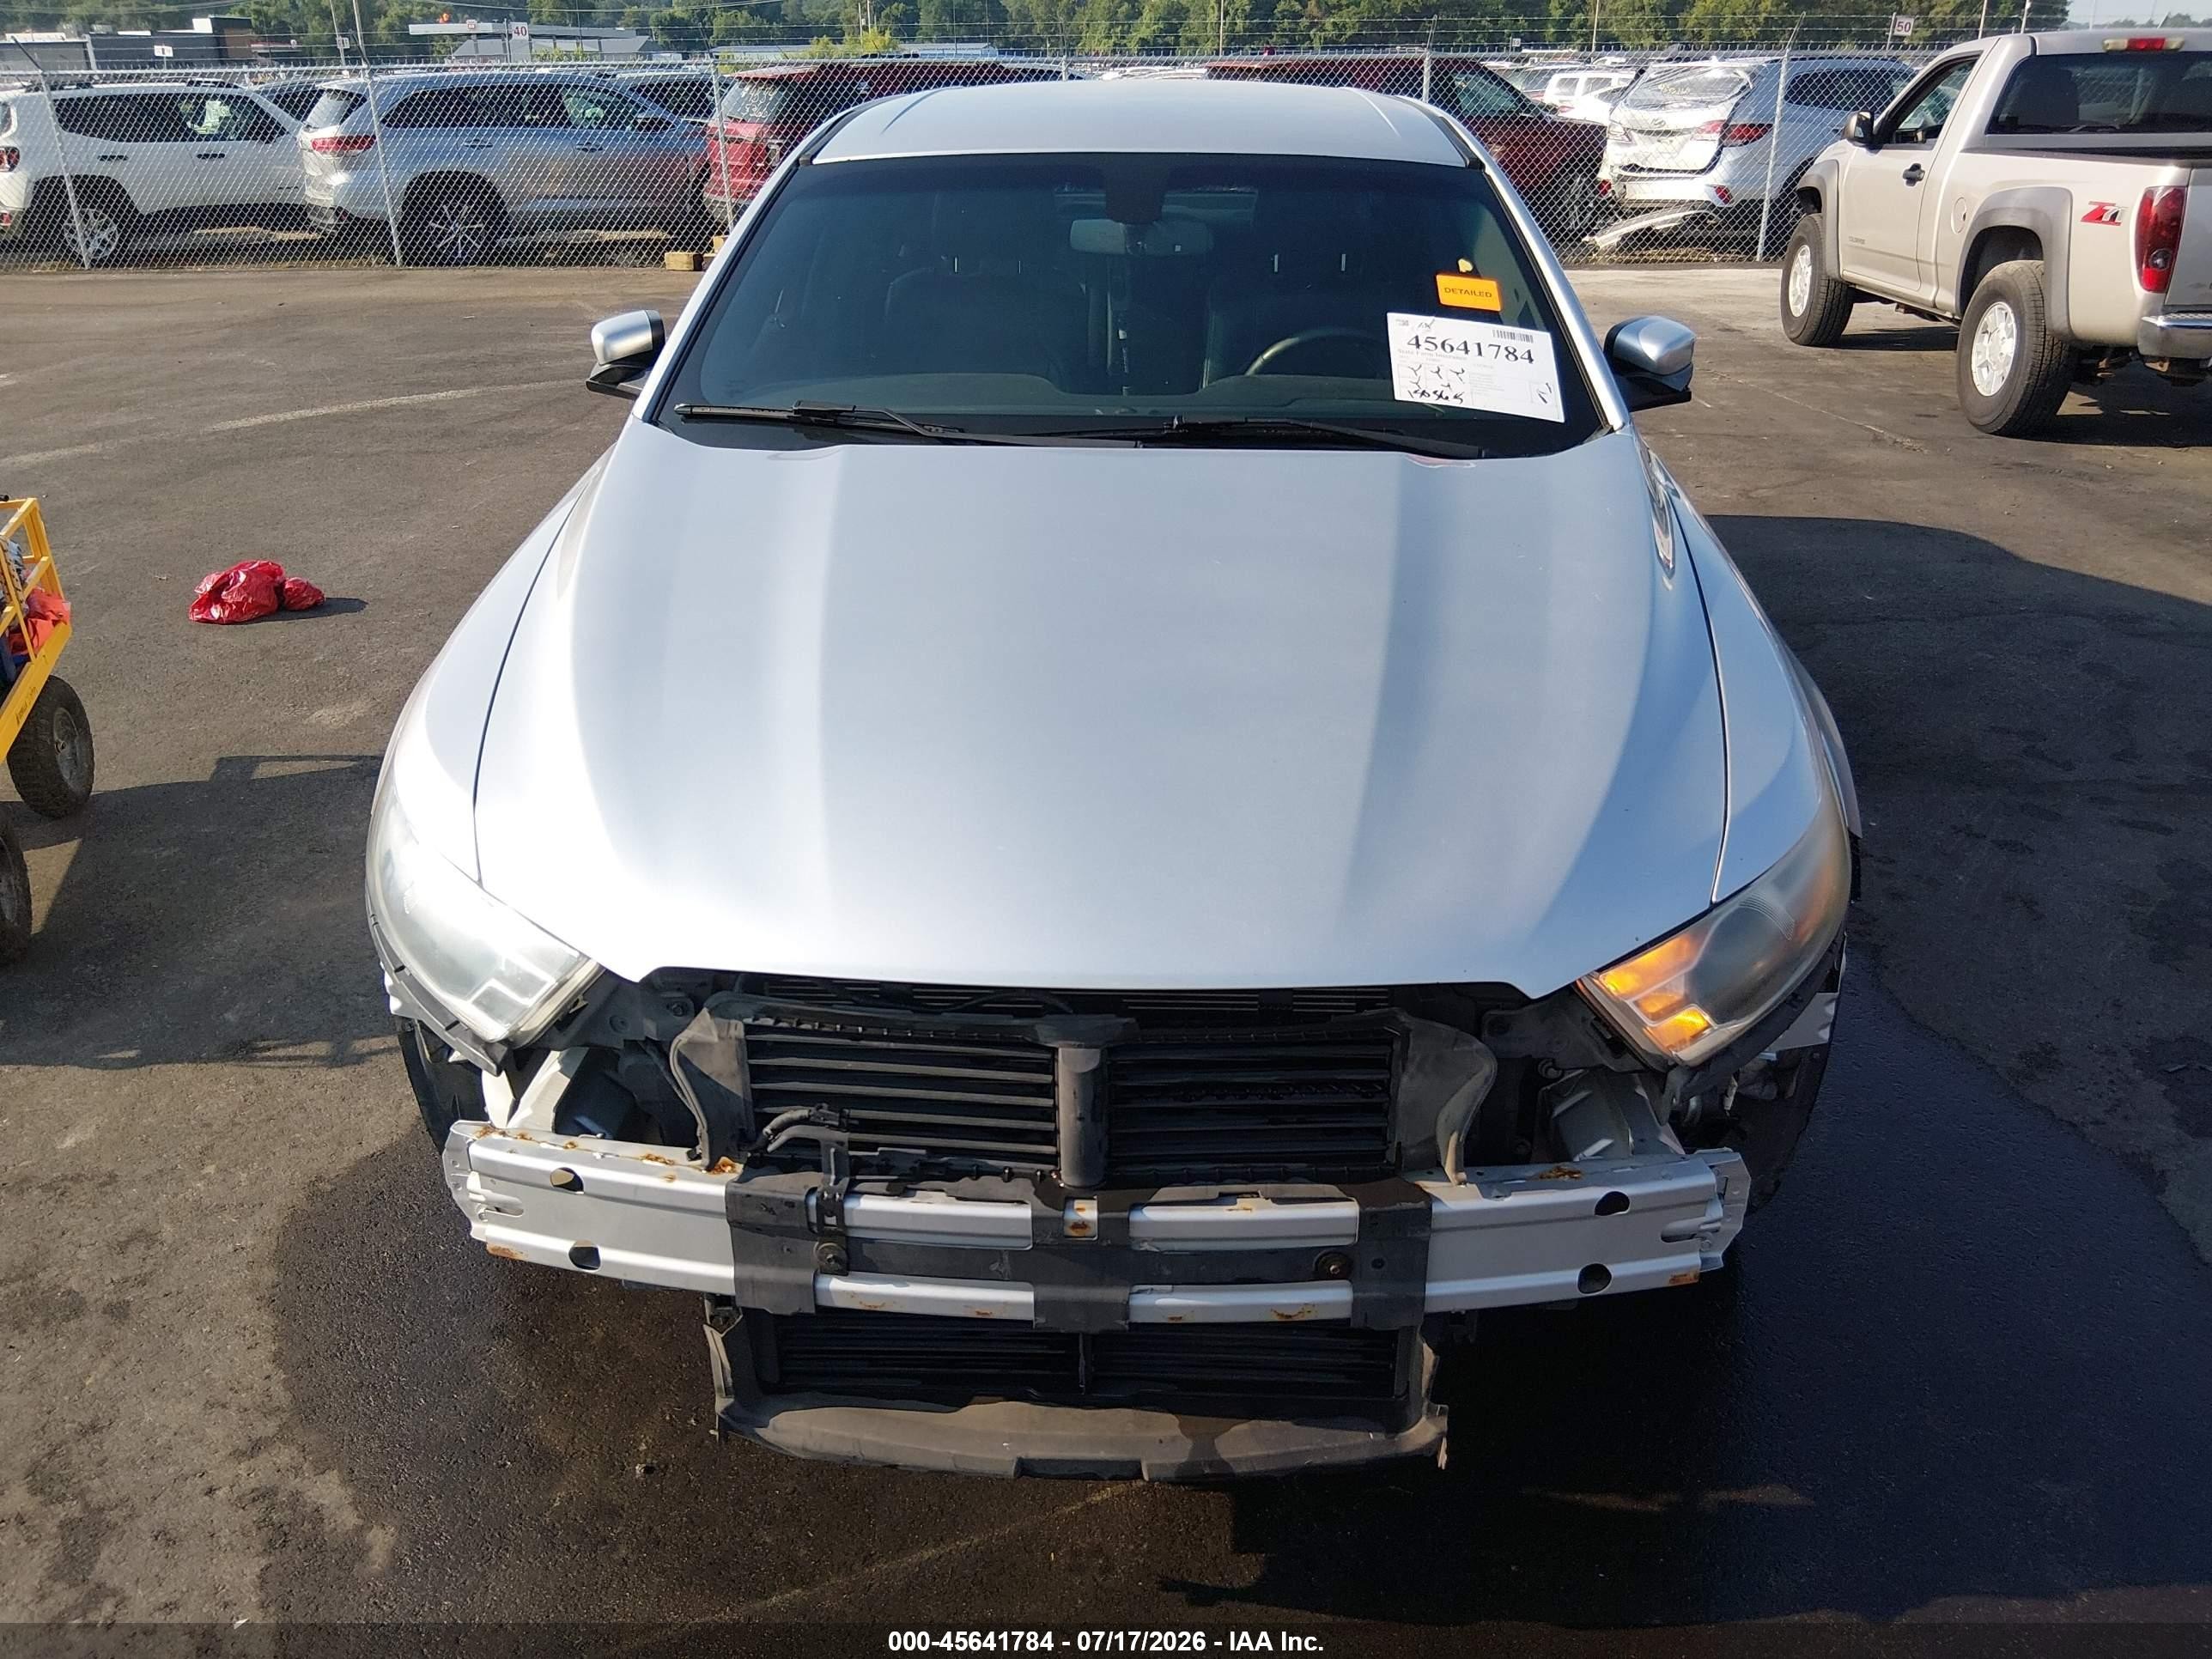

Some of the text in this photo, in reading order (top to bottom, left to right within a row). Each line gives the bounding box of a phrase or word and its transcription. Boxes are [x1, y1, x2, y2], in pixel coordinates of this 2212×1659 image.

[514, 26, 527, 36] 40
[1896, 21, 1911, 33] 50
[1443, 287, 1492, 298] DETAILED
[1407, 334, 1534, 364] 45641784
